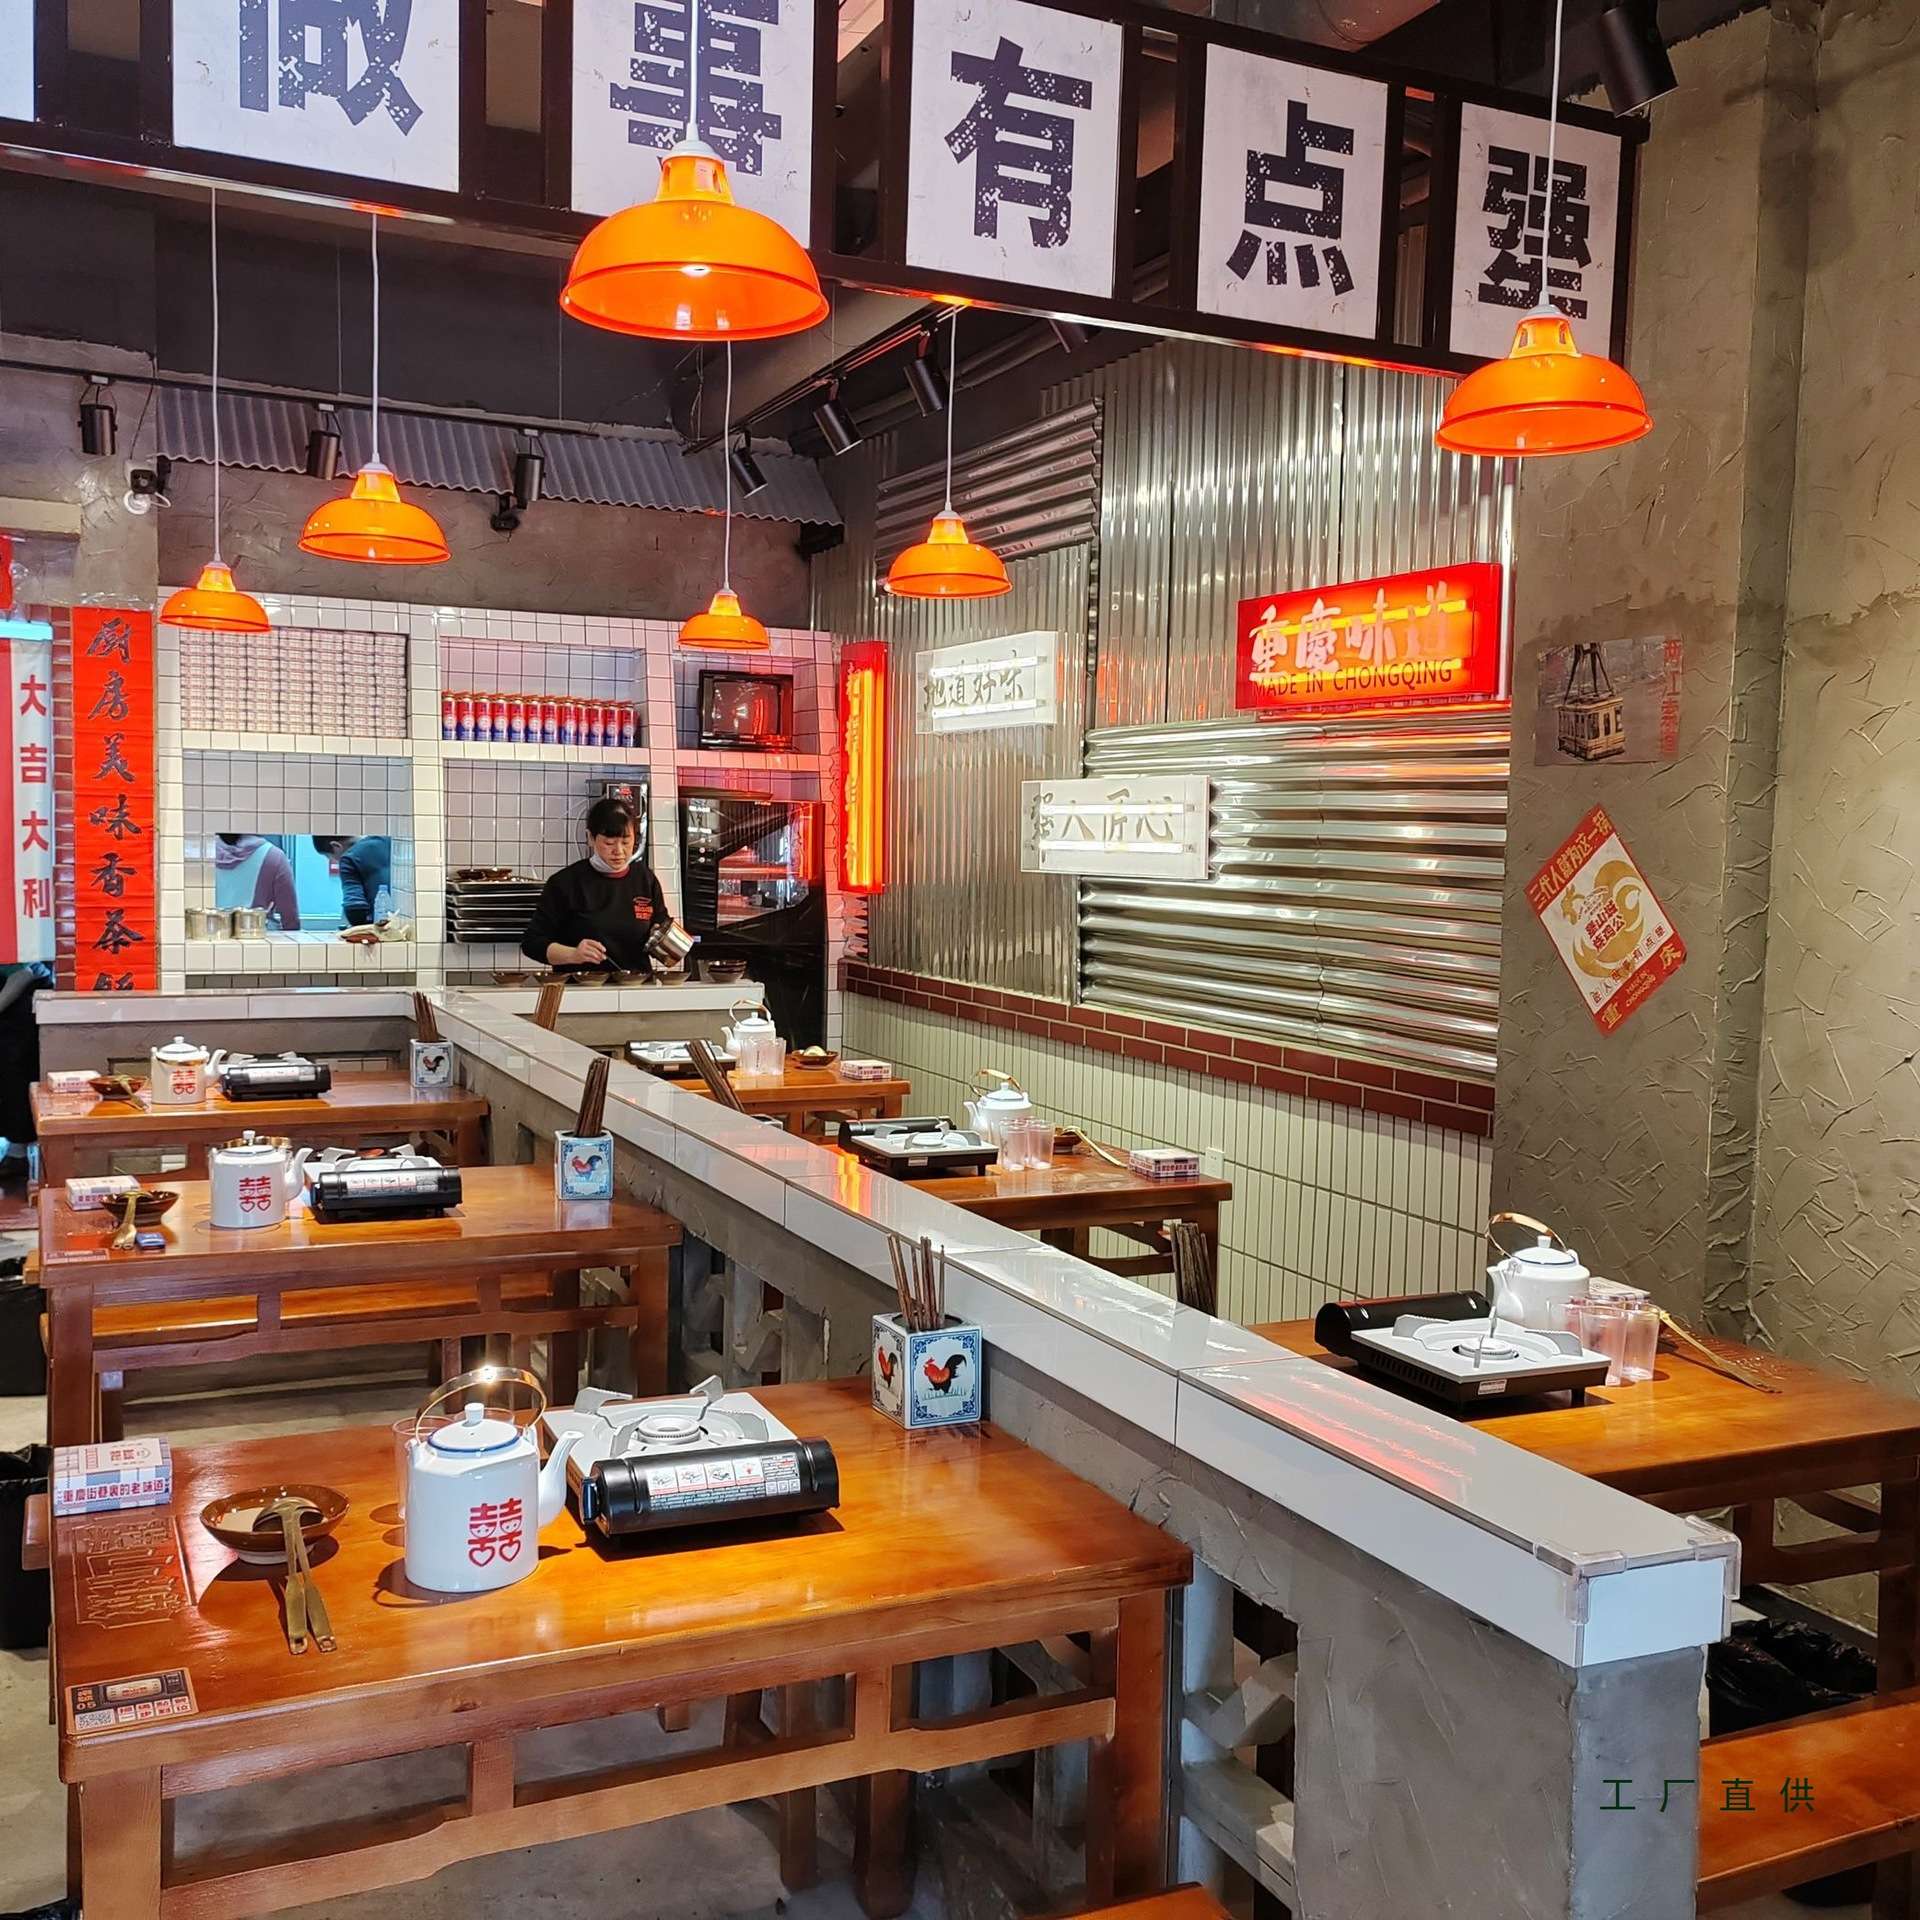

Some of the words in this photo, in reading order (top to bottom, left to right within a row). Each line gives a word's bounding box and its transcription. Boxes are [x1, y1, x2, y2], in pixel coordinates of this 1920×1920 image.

[1254, 678, 1297, 696] MADE
[1305, 669, 1324, 693] IN
[1333, 657, 1452, 691] CHONGQING
[19, 674, 52, 919] 大吉大利
